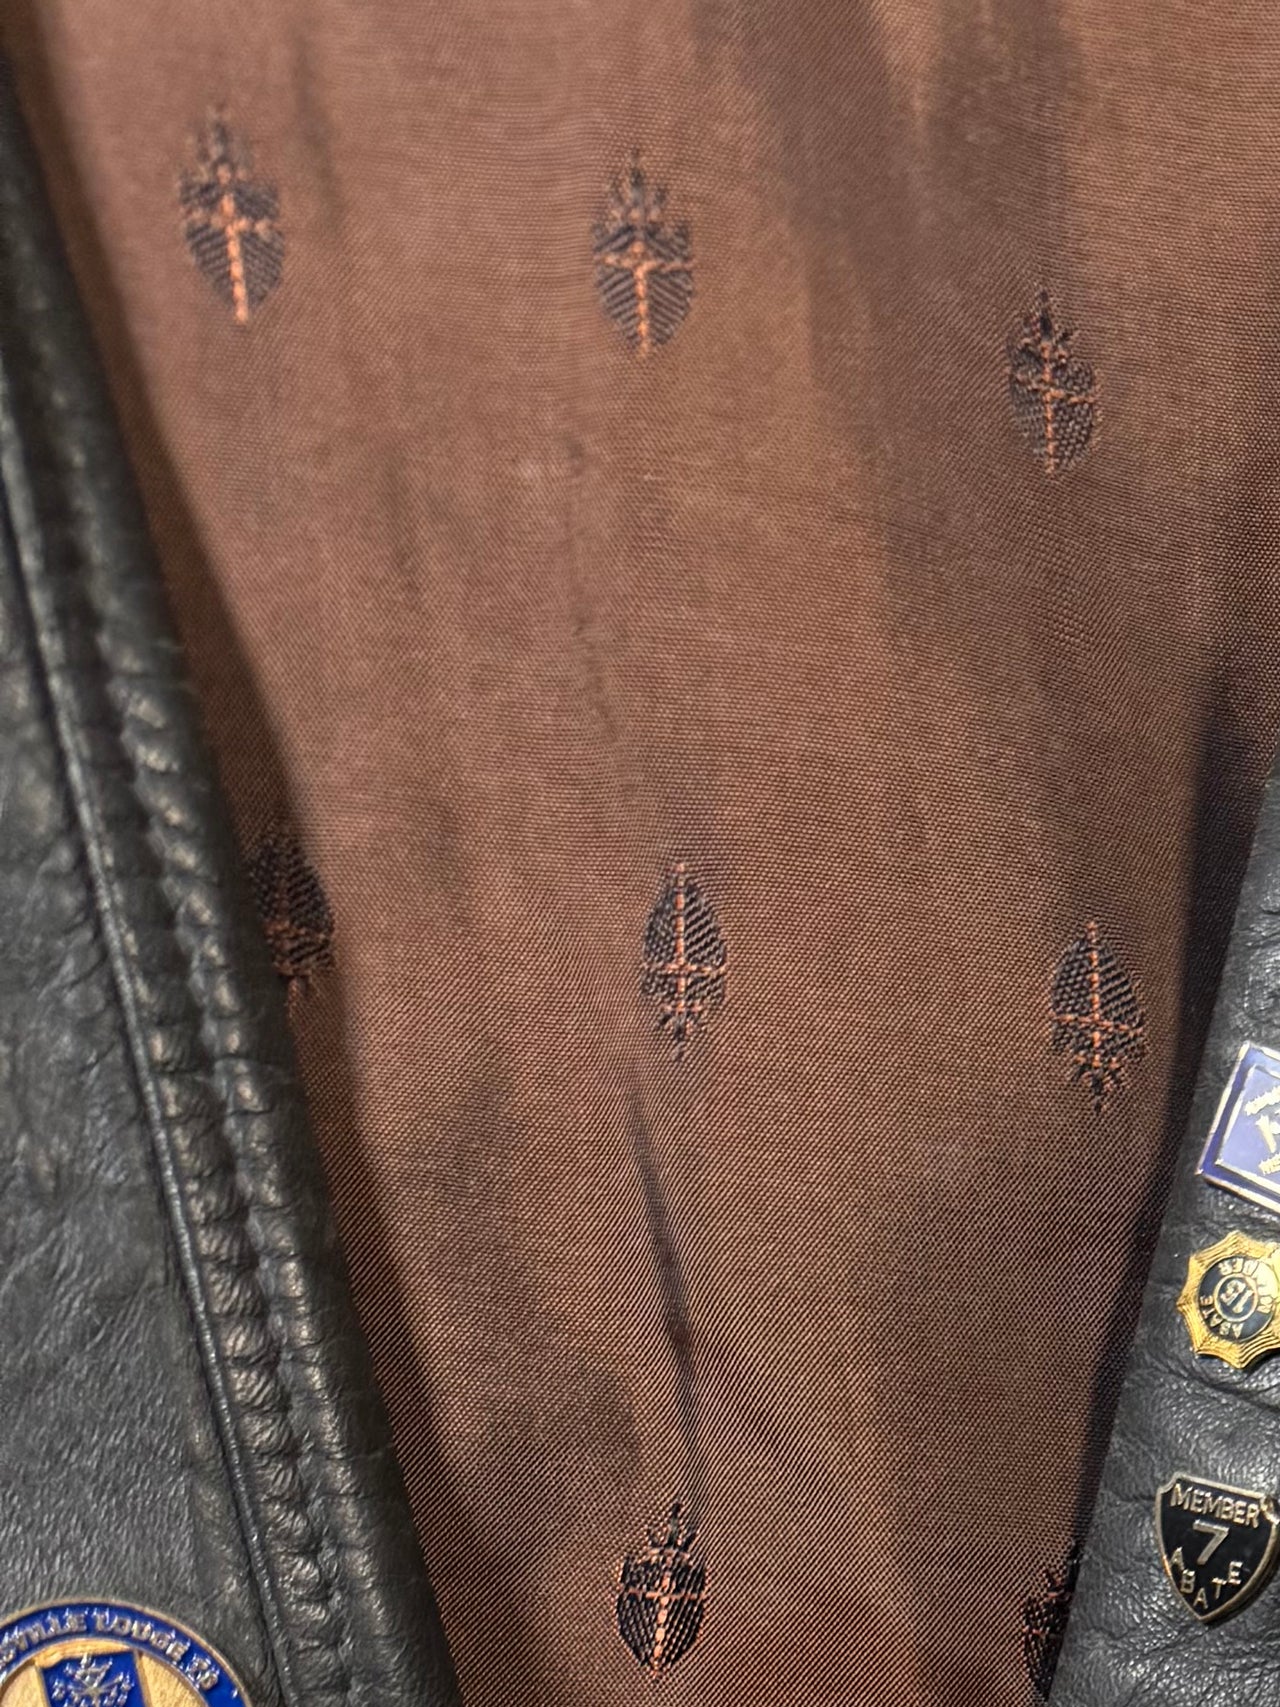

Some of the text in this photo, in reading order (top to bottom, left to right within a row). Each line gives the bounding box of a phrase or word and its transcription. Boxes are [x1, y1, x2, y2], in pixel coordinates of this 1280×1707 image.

[1169, 1482, 1261, 1529] MEMBER
[1192, 1518, 1230, 1566] 7
[1169, 1546, 1244, 1609] ABATE
